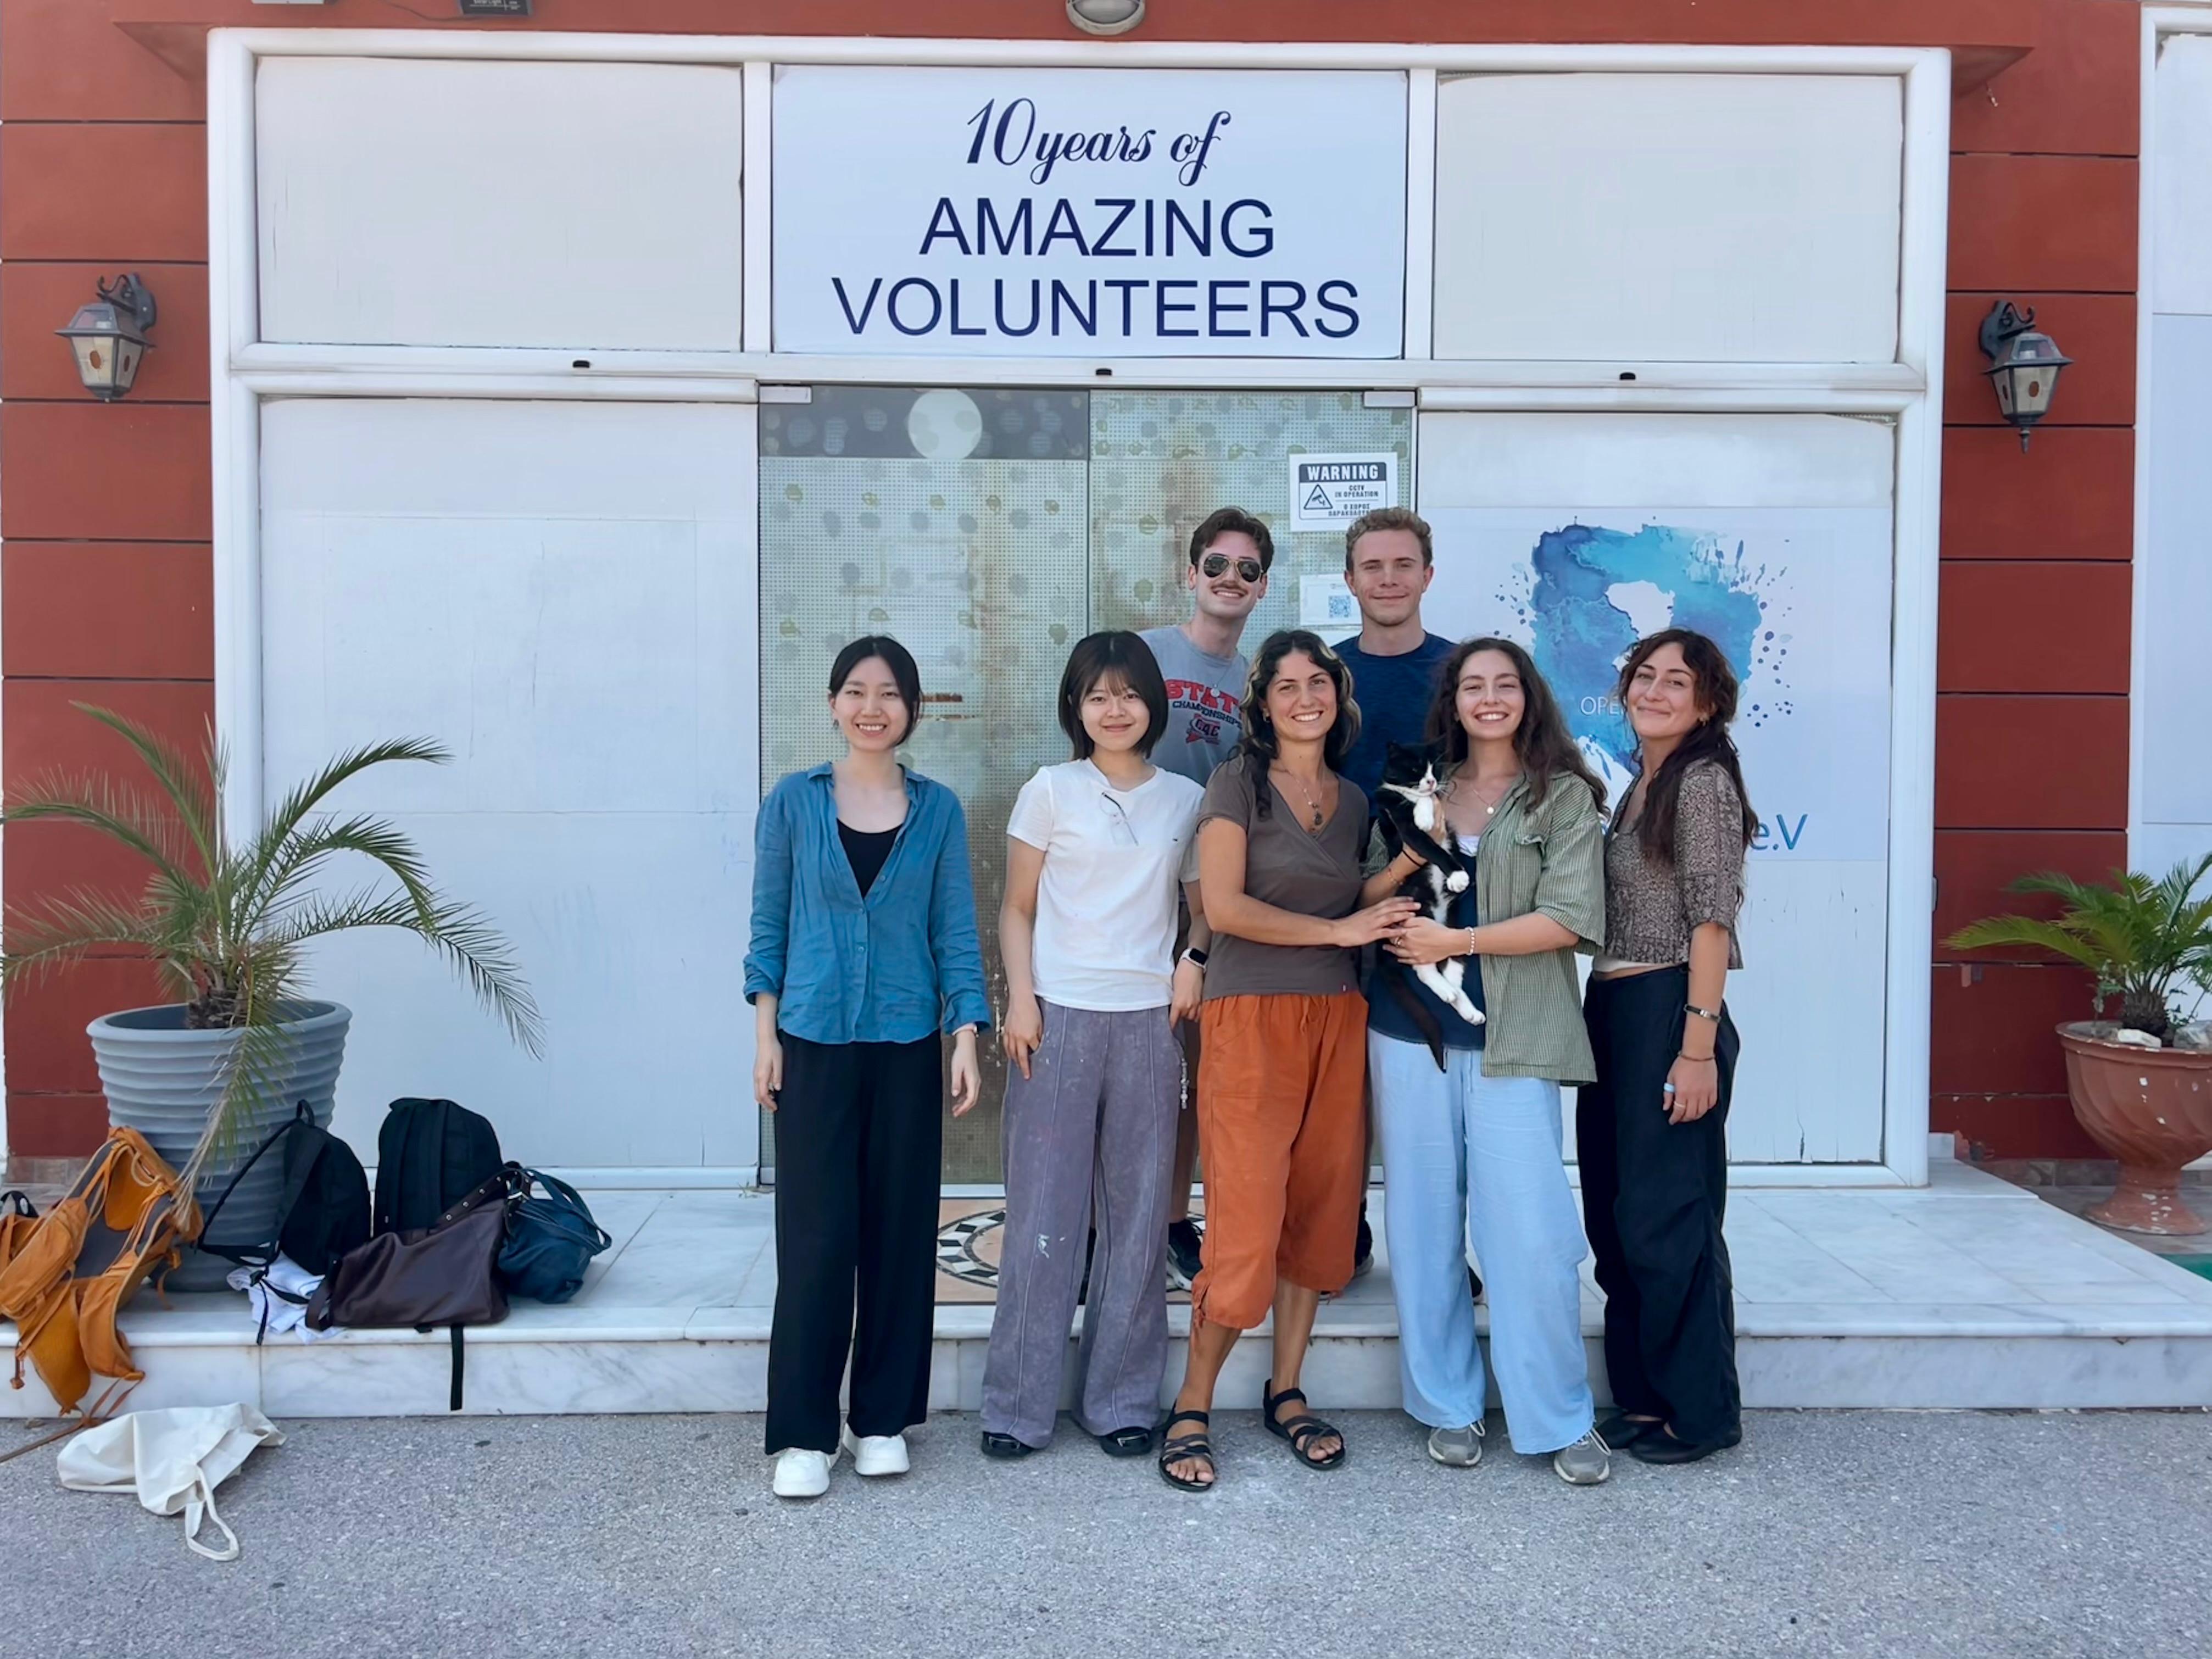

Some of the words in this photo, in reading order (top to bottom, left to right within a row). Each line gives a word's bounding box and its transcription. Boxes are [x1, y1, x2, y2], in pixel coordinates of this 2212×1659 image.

[967, 98, 1035, 165] 10
[1030, 126, 1156, 185] years
[1171, 111, 1231, 187] of
[919, 197, 1273, 258] AMAZING
[831, 277, 1359, 338] VOLUNTEERS
[1307, 465, 1379, 481] WARNING
[1165, 679, 1241, 715] STAT
[1580, 695, 1624, 716] OPE
